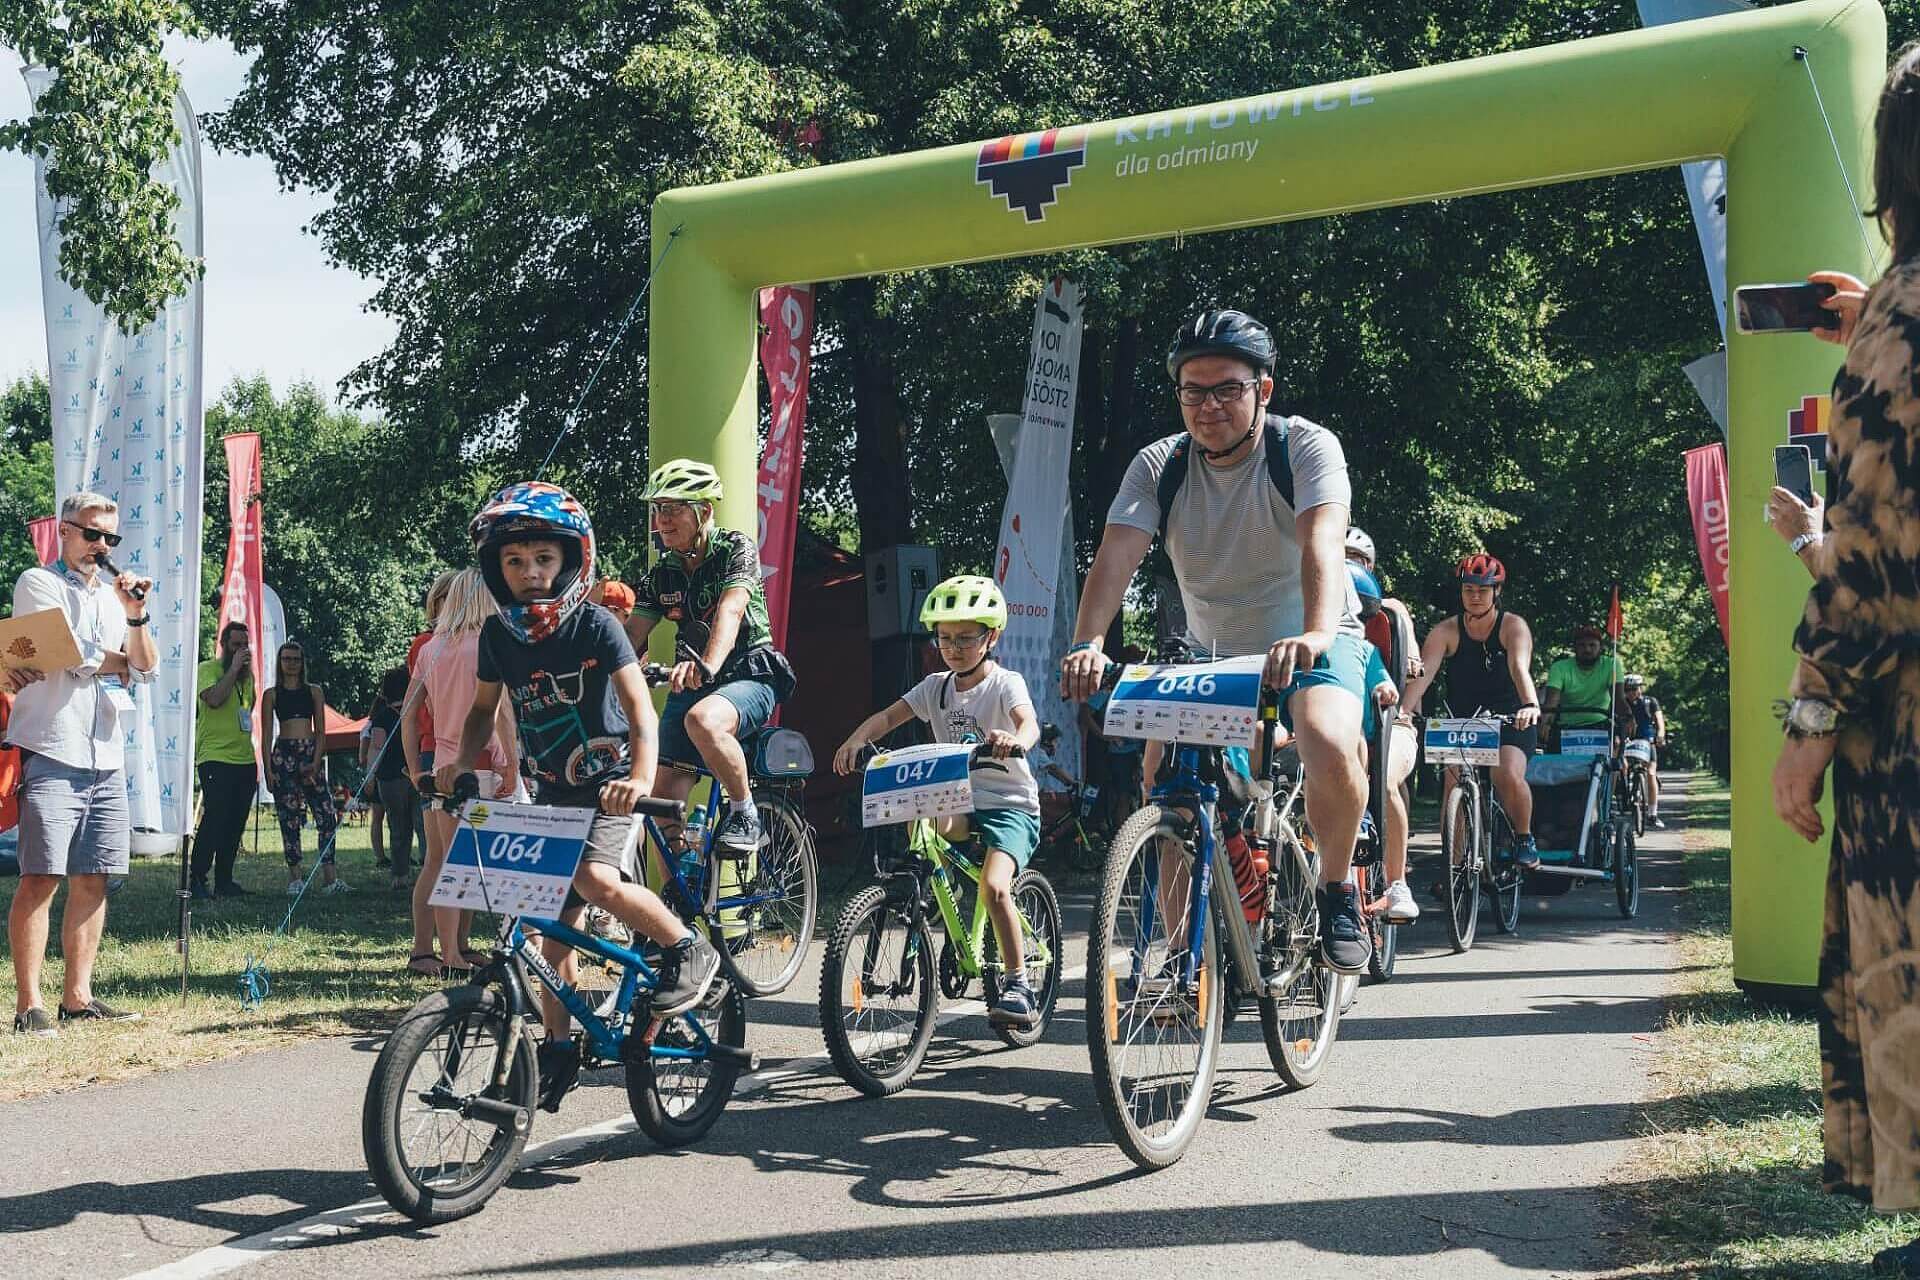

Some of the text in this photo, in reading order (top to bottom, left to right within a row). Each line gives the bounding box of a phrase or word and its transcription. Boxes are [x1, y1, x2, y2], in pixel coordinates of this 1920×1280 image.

[1115, 83, 1375, 145] KATOWICE
[1115, 137, 1259, 178] dla odmiany
[1157, 673, 1217, 697] 046
[1447, 731, 1479, 745] 049
[895, 758, 939, 784] 047
[488, 833, 548, 865] 064
